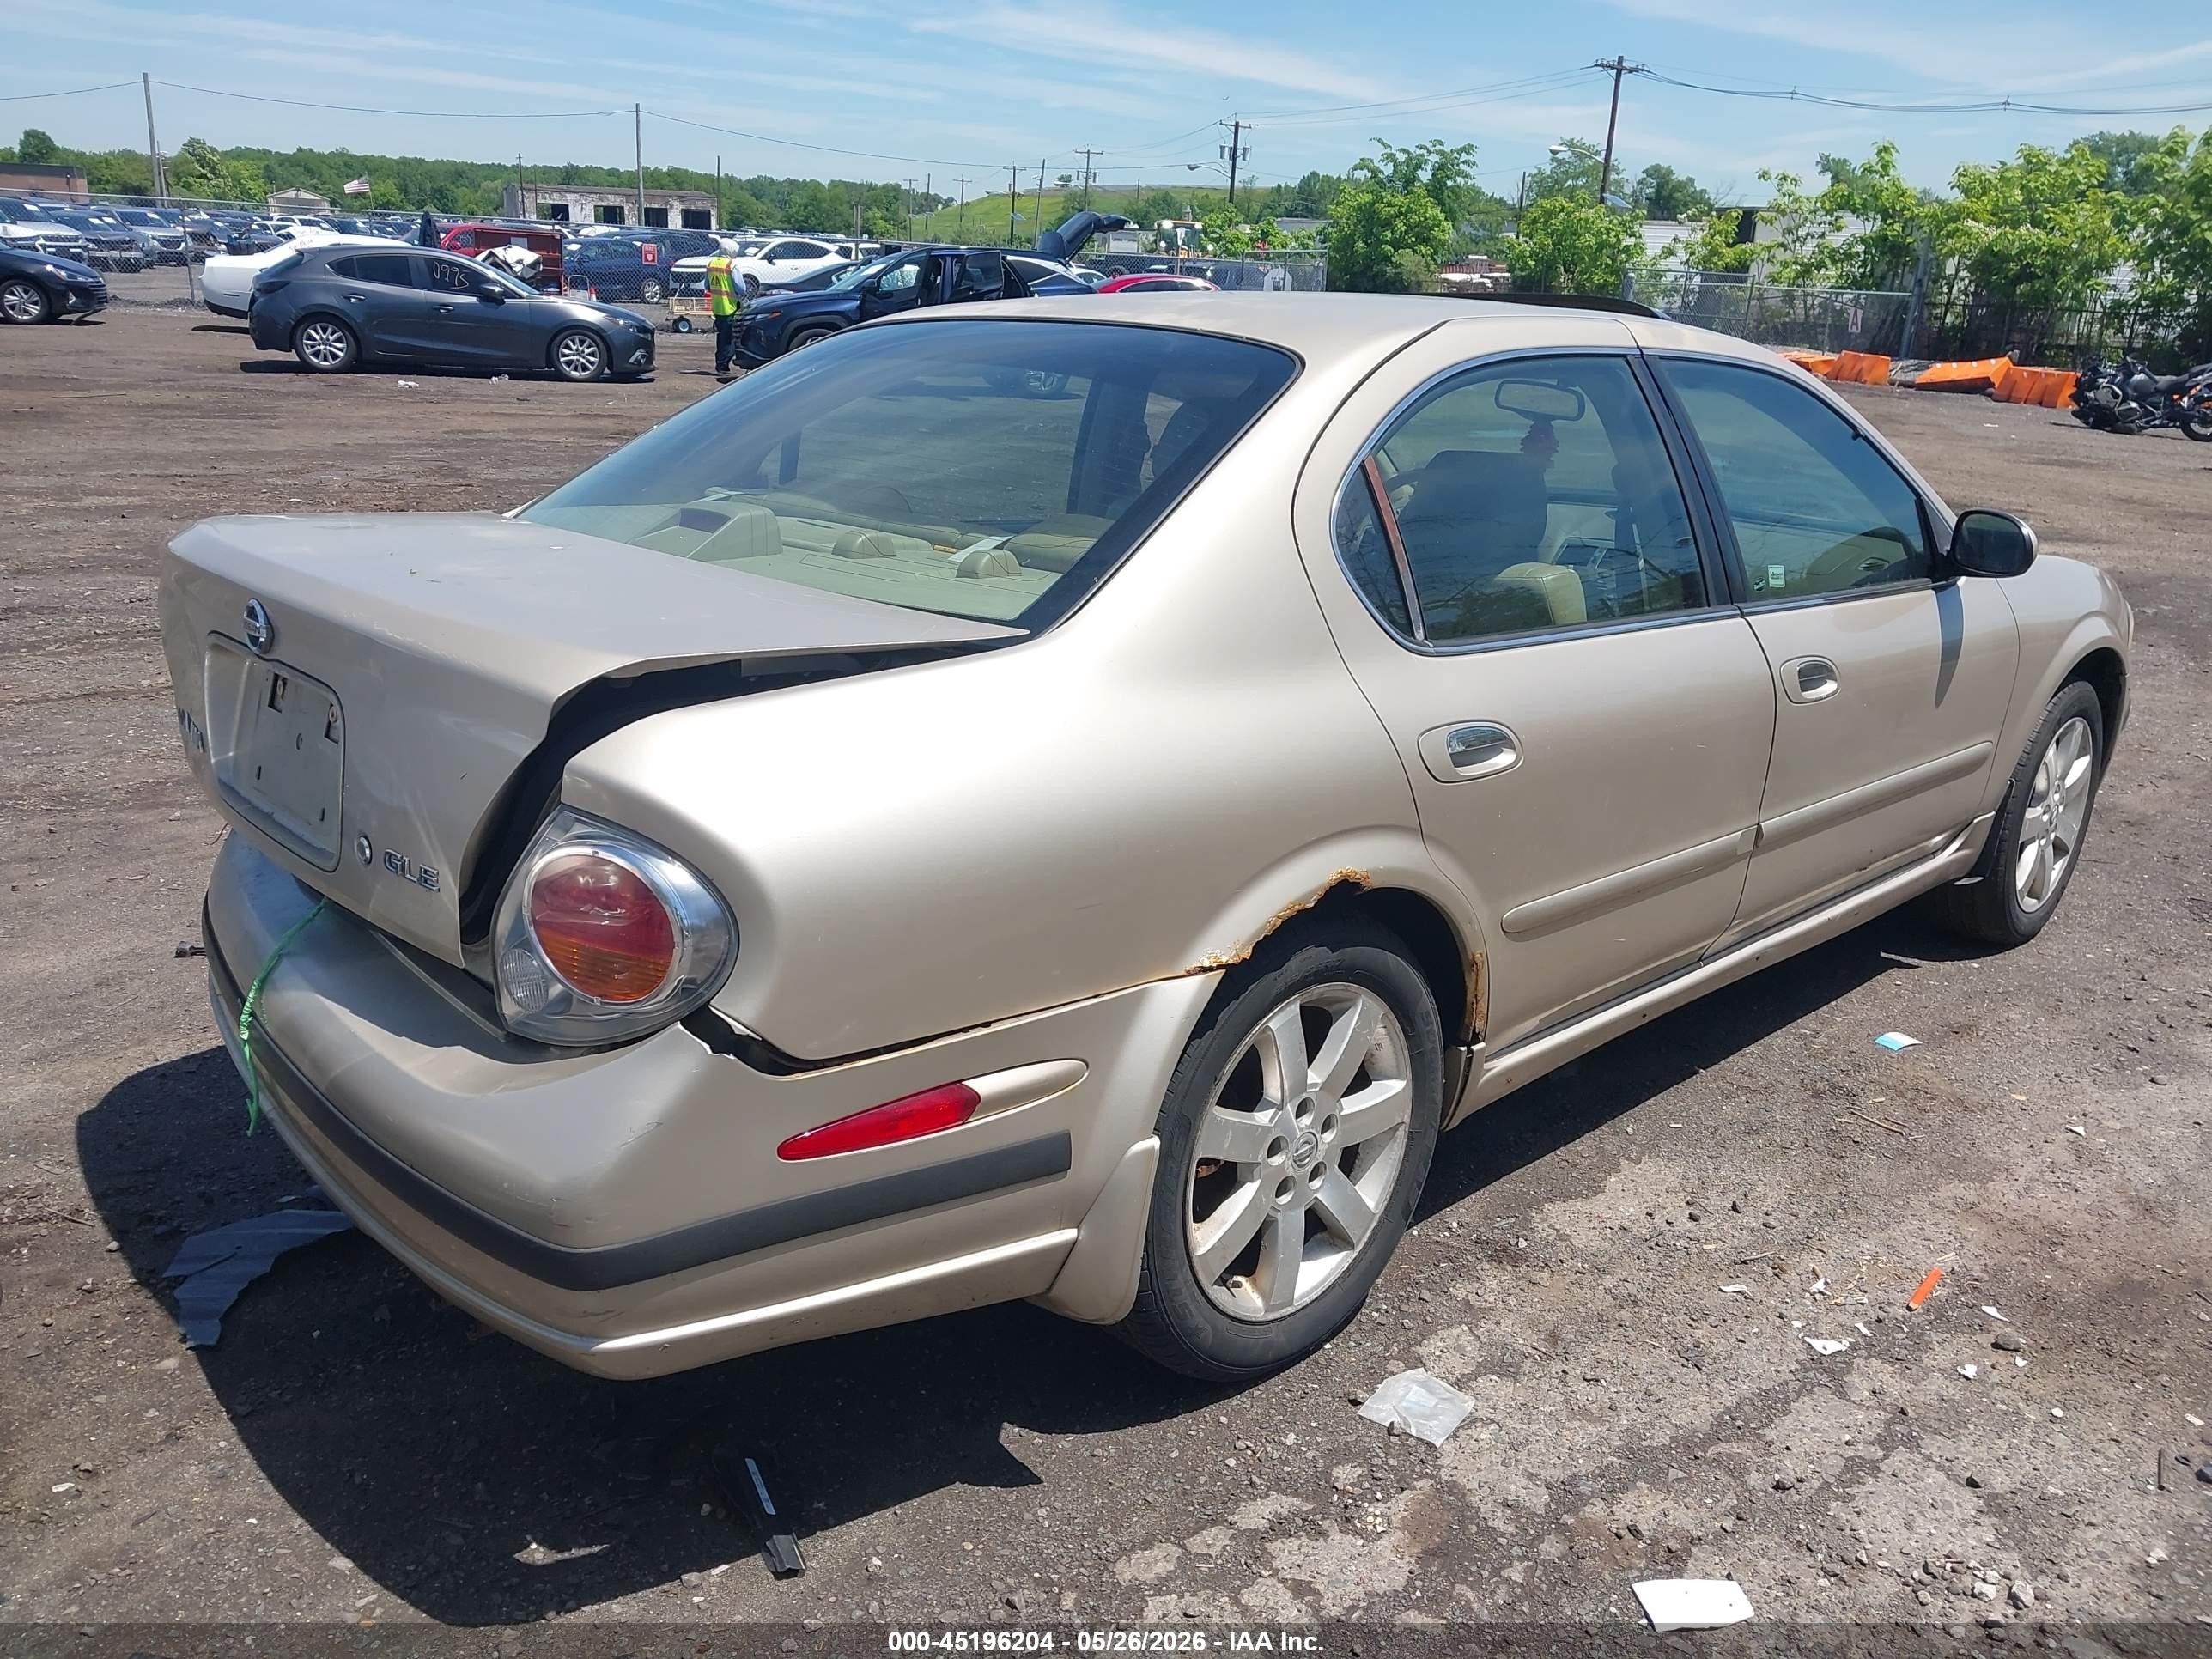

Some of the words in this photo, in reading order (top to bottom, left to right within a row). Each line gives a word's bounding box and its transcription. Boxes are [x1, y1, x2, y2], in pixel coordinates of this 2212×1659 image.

[433, 261, 471, 289] 0995
[1850, 309, 1859, 331] A
[384, 848, 440, 893] GLE
